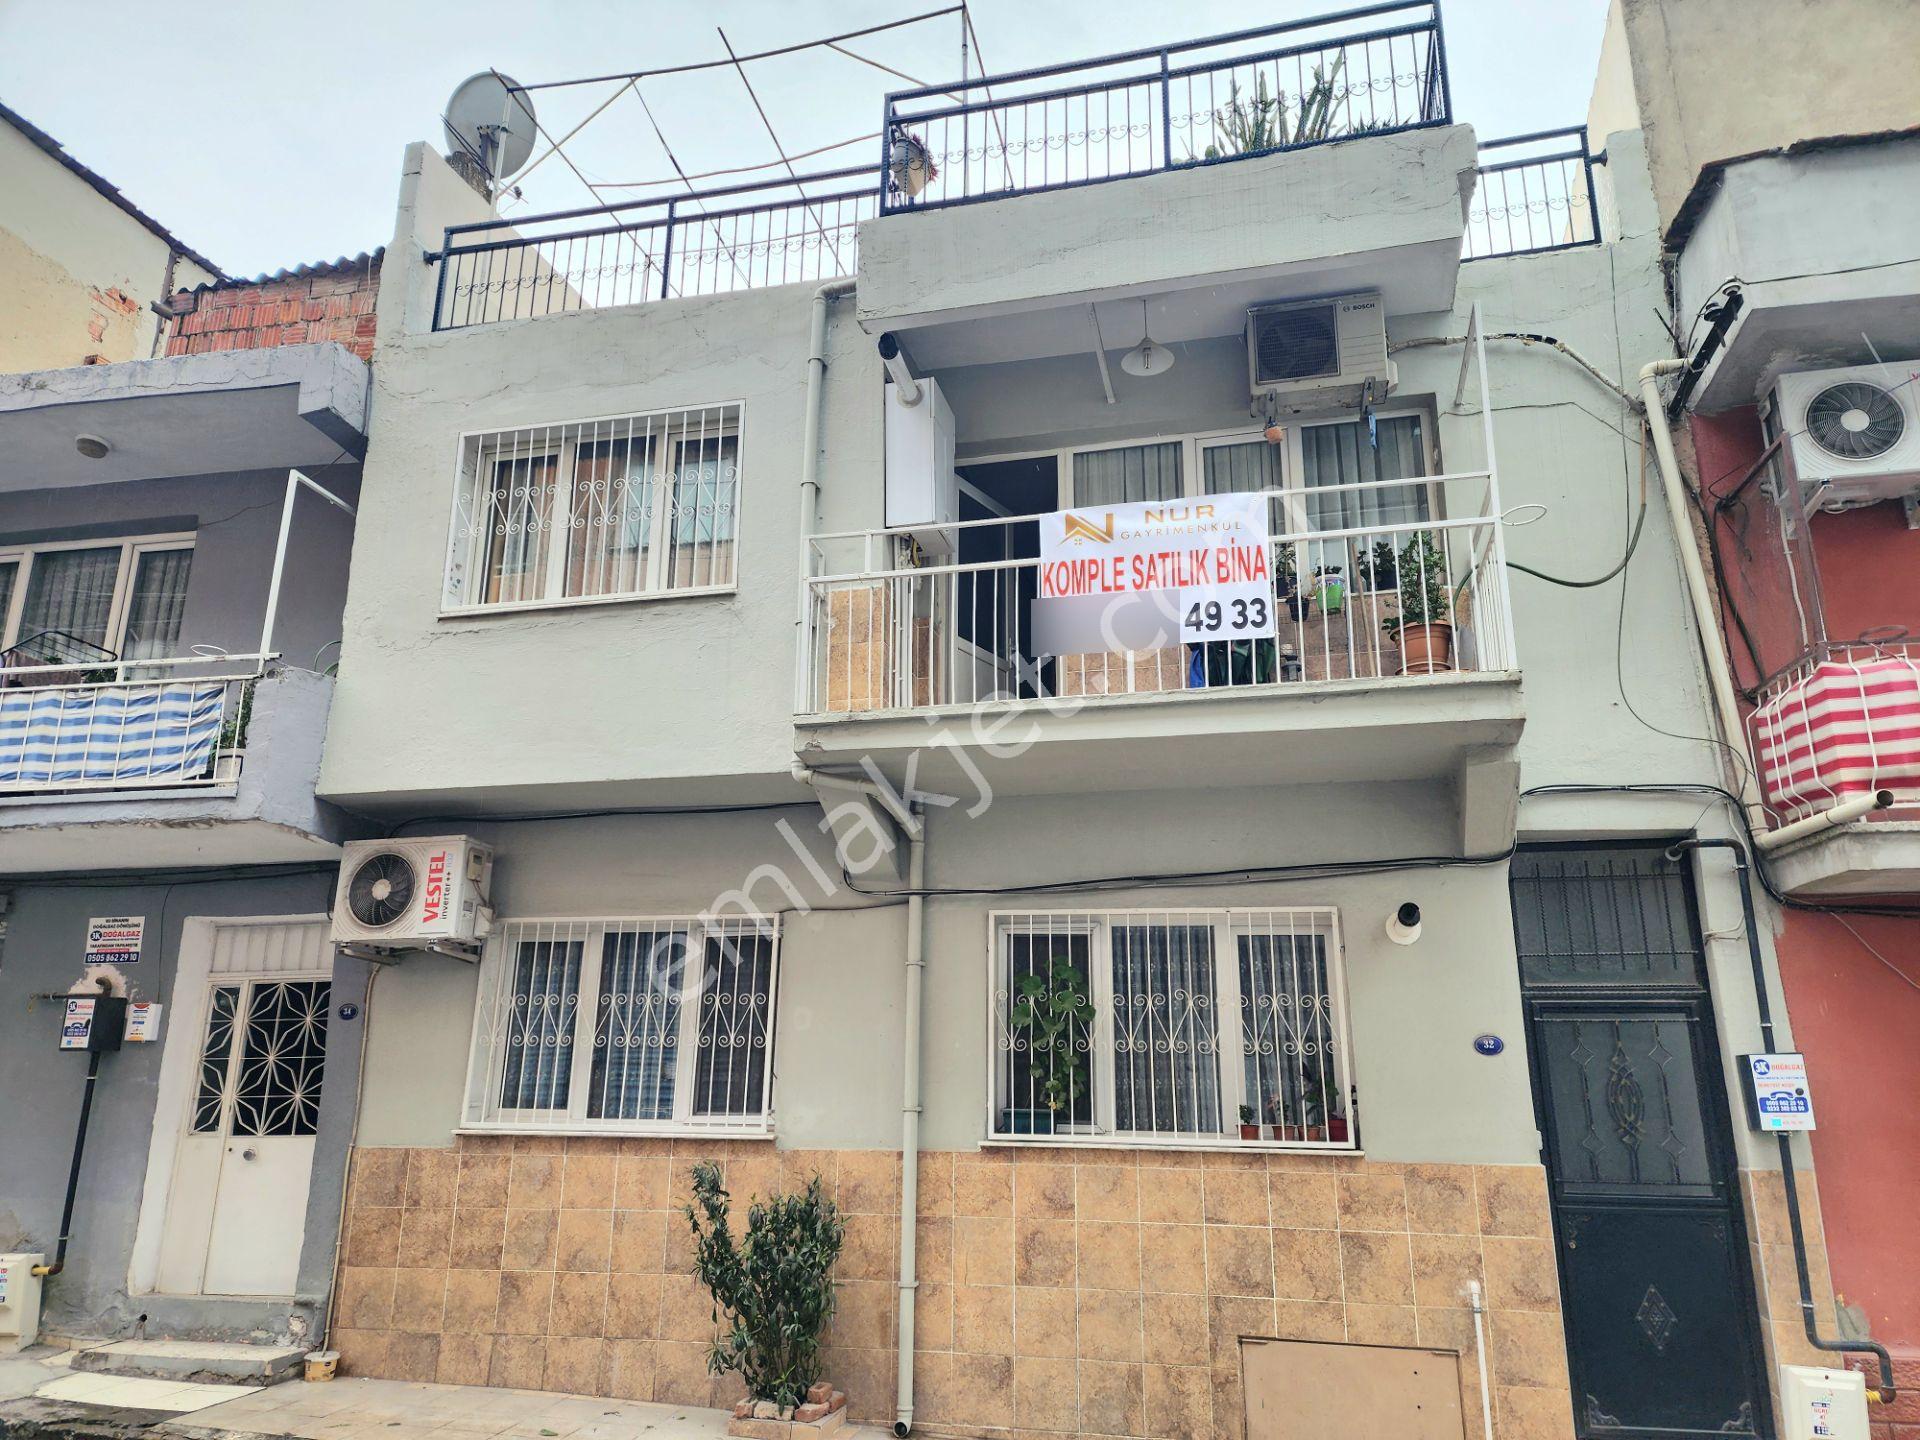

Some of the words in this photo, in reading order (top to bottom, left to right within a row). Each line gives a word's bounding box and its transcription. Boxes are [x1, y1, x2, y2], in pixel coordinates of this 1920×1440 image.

[1352, 303, 1375, 311] BOSCH
[1120, 521, 1241, 540] GAYRİMENKUL
[1042, 555, 1125, 597] KOMPLE
[1132, 548, 1211, 590] SATILIK
[1216, 537, 1268, 584] BİNA
[1185, 601, 1222, 632] 49
[1231, 597, 1268, 630] 33
[422, 850, 446, 923] VESTEL
[1483, 1040, 1495, 1049] 32
